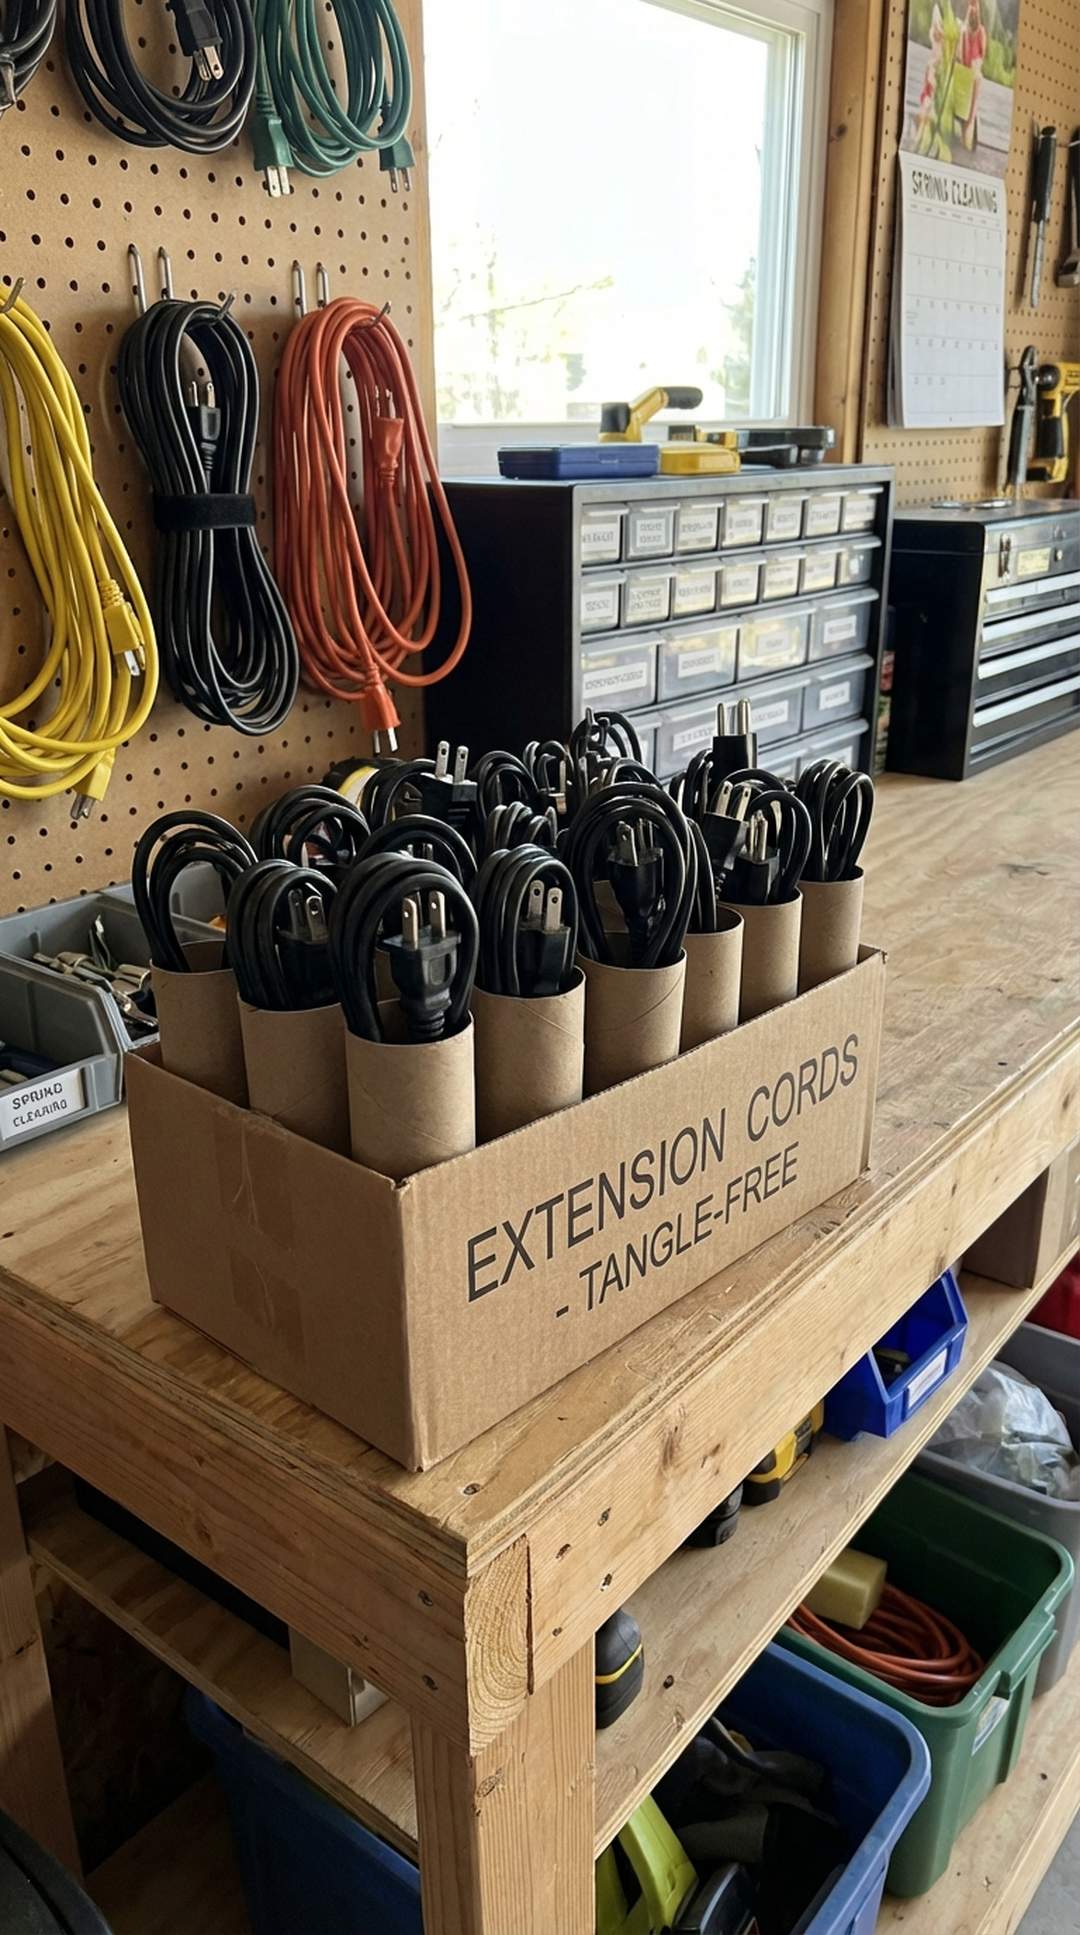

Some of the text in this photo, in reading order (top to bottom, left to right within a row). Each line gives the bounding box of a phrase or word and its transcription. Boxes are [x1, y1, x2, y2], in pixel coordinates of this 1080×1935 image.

[467, 1033, 859, 1303] EXTENSION CORDS
[578, 1140, 800, 1312] TANGLE-FREE
